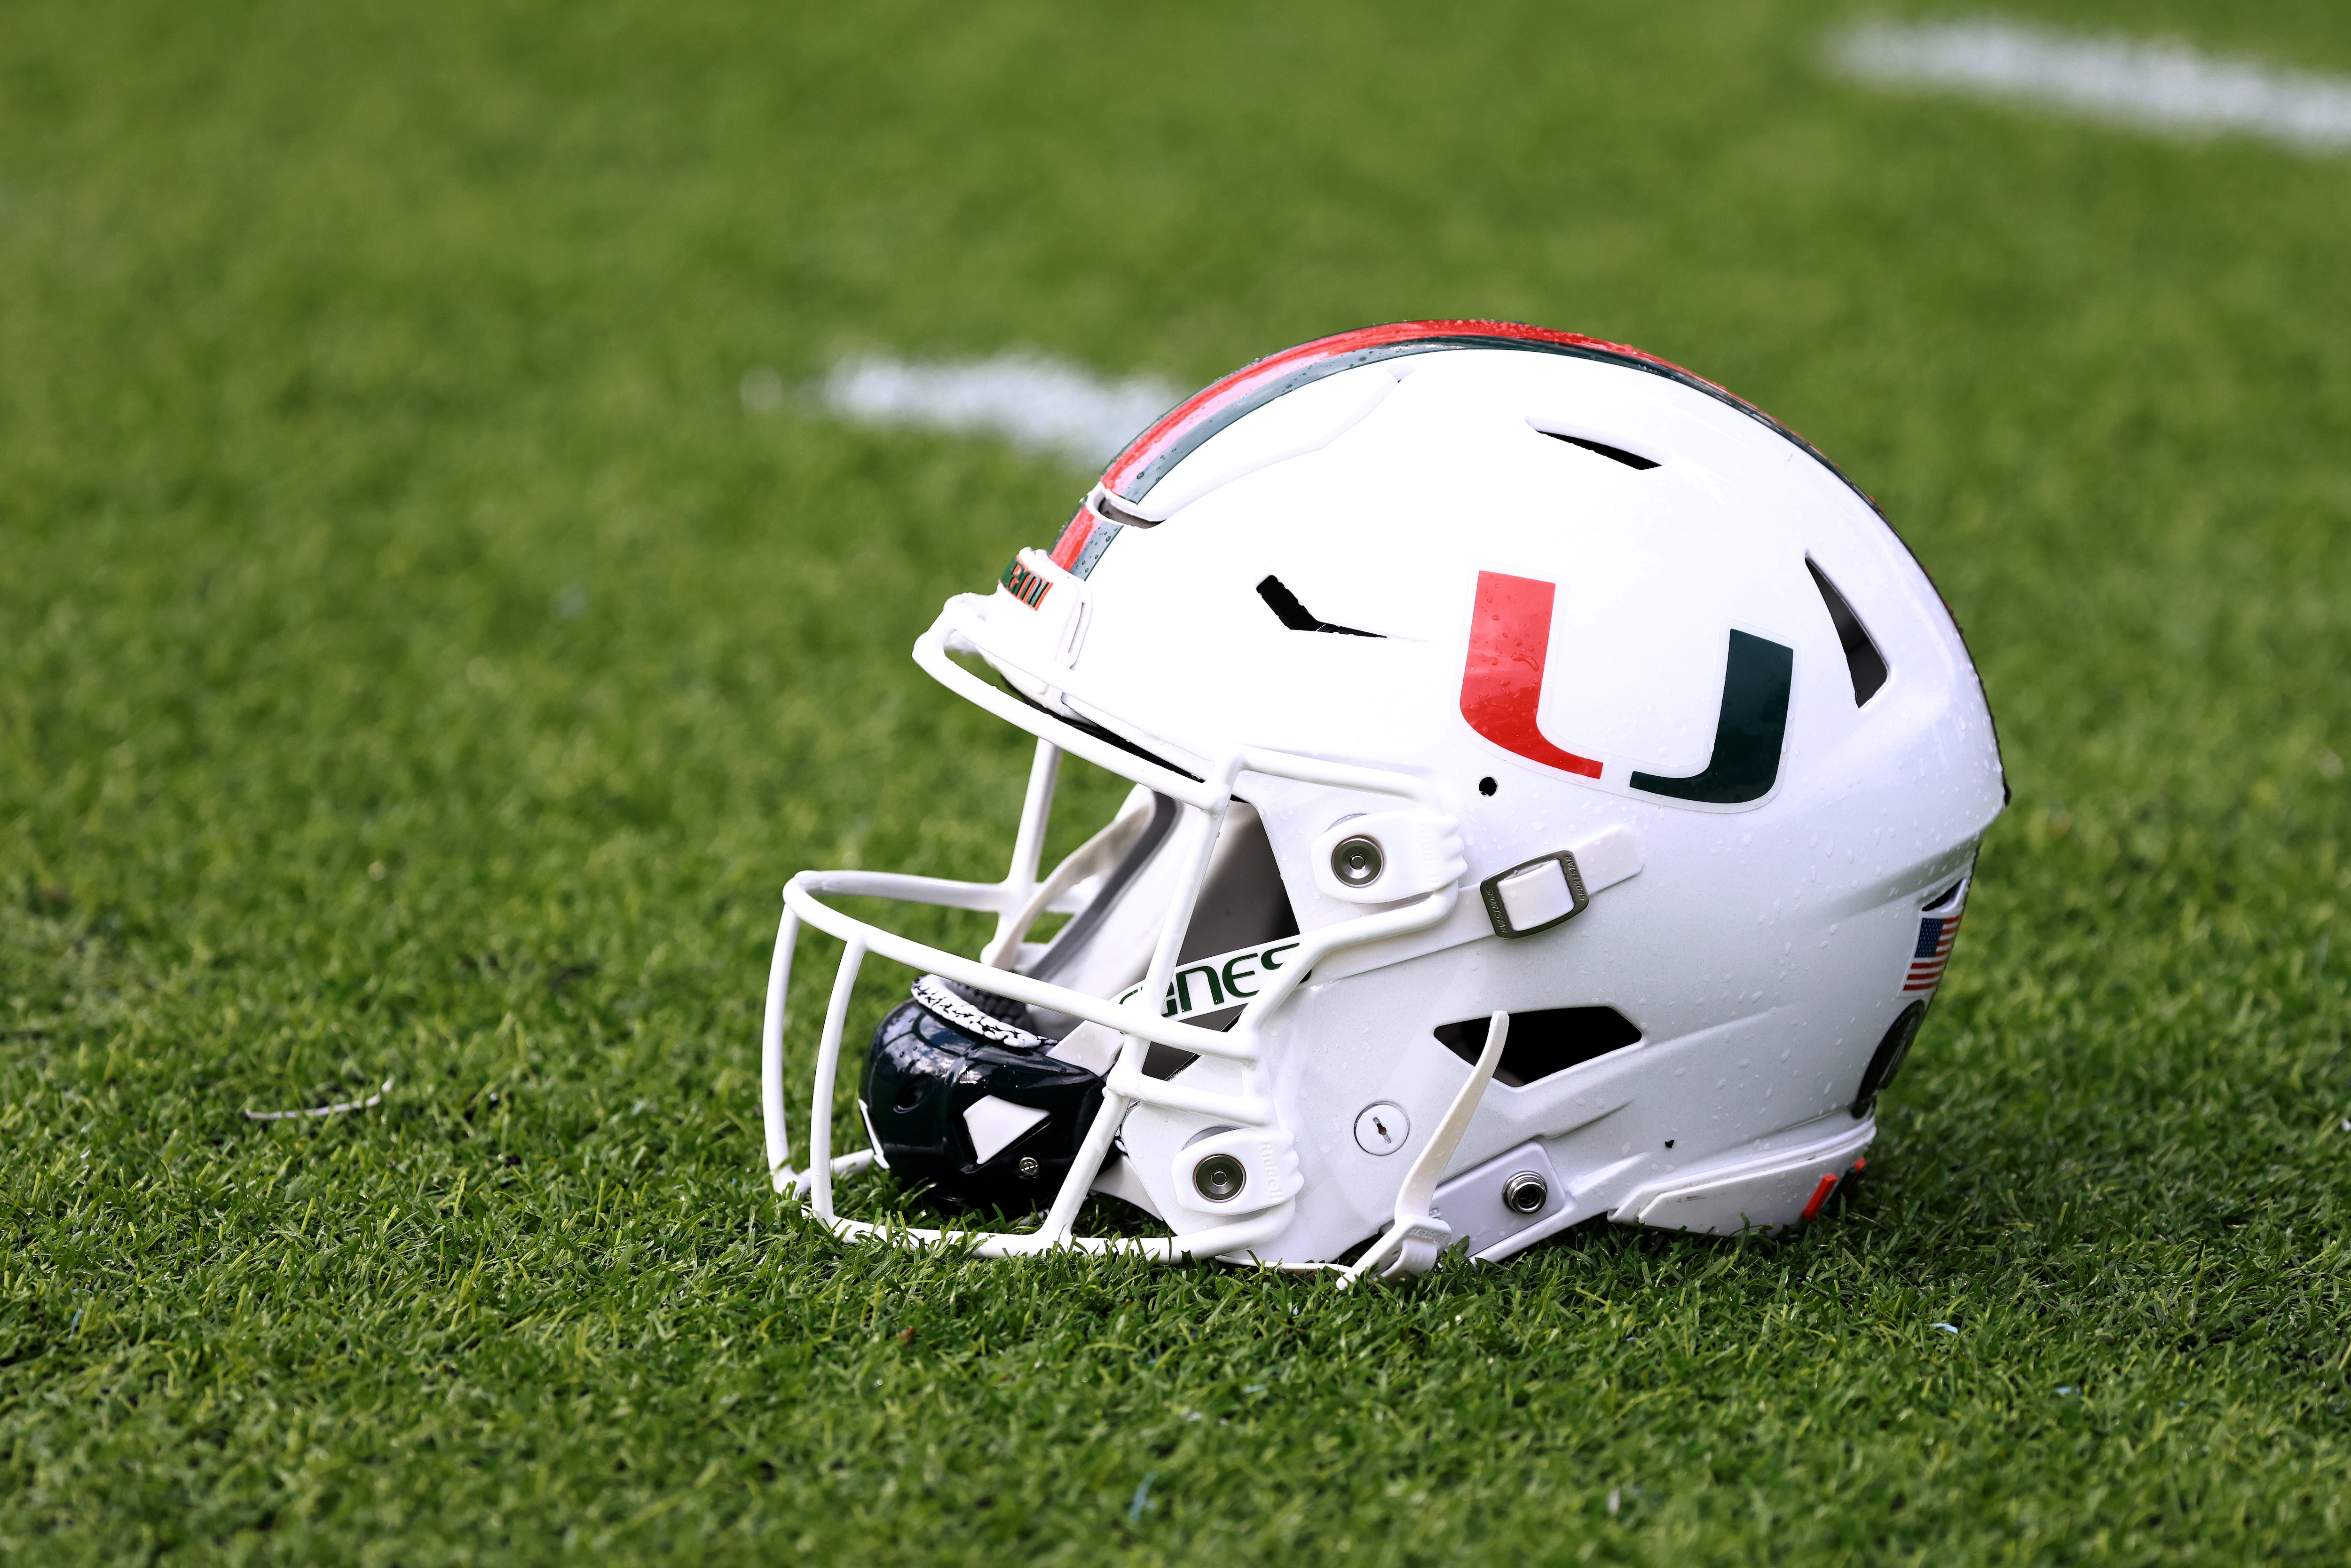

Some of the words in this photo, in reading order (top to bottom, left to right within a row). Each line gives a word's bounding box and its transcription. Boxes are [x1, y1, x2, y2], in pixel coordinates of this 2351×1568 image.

[1460, 570, 1793, 804] U
[1565, 856, 1587, 901] SPORTSTAR
[1486, 889, 1508, 934] SPORTSTAR
[1261, 1142, 1283, 1201] Riddell
